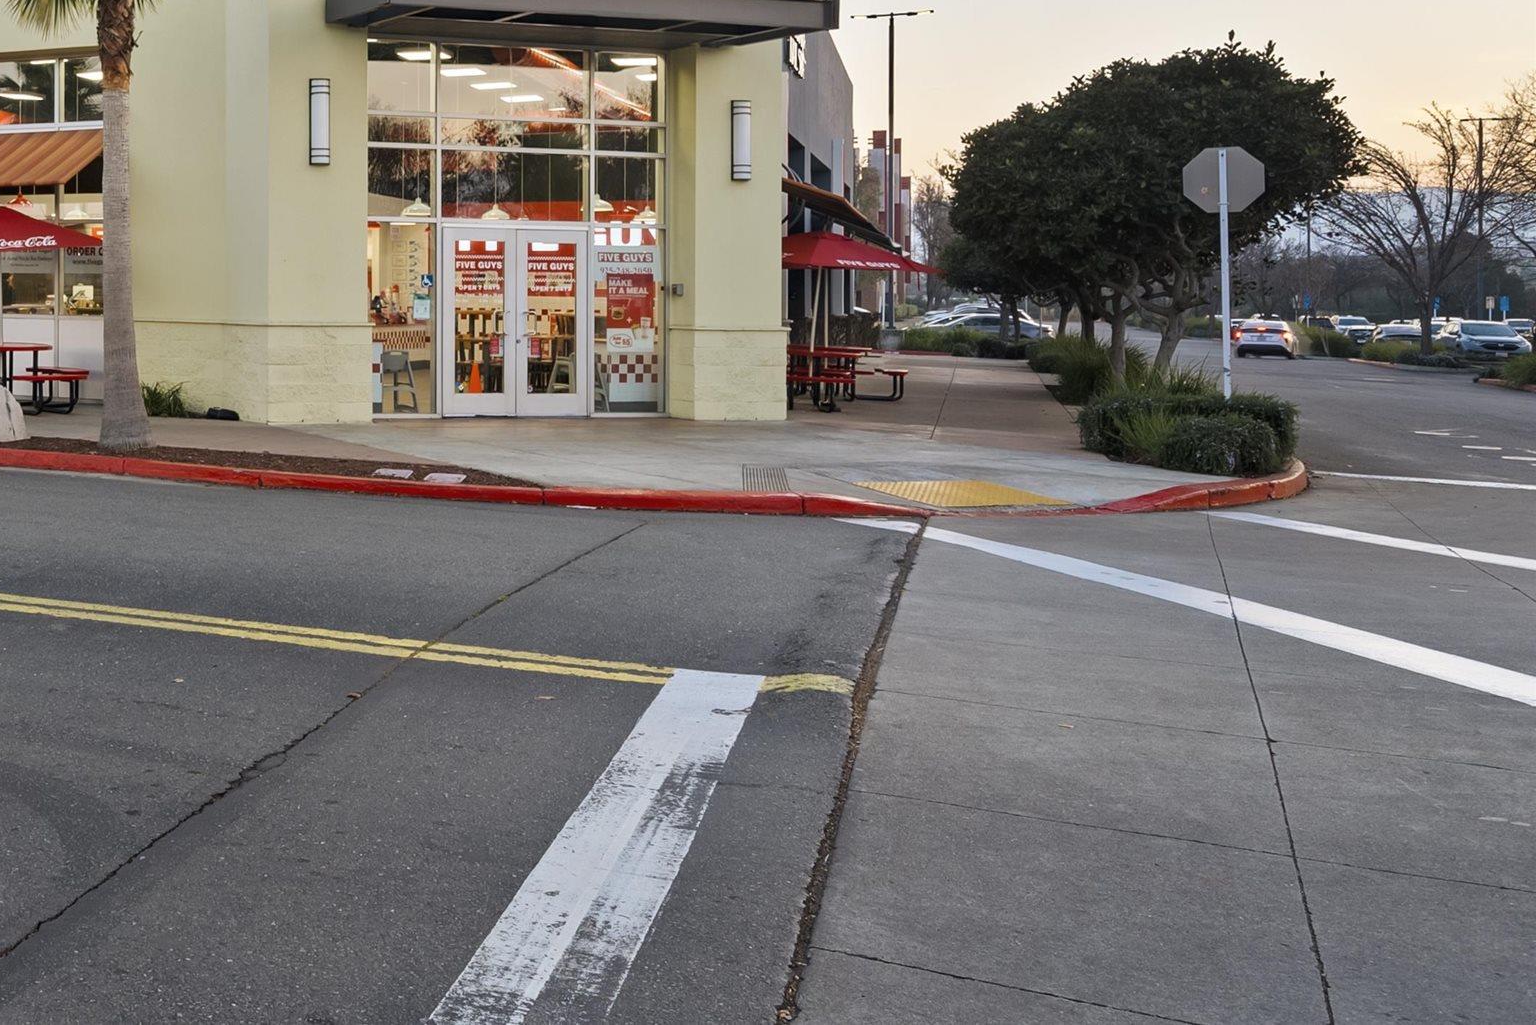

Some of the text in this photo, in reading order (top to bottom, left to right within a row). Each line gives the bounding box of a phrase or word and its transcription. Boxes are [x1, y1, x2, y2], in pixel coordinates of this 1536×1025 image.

[66, 246, 96, 256] ORDER
[598, 253, 653, 262] FIVE GUYS
[456, 260, 503, 269] FIVE GUYS
[528, 262, 574, 271] FIVE GUYS
[609, 279, 633, 287] MAKE
[608, 286, 648, 295] IT A MEAL
